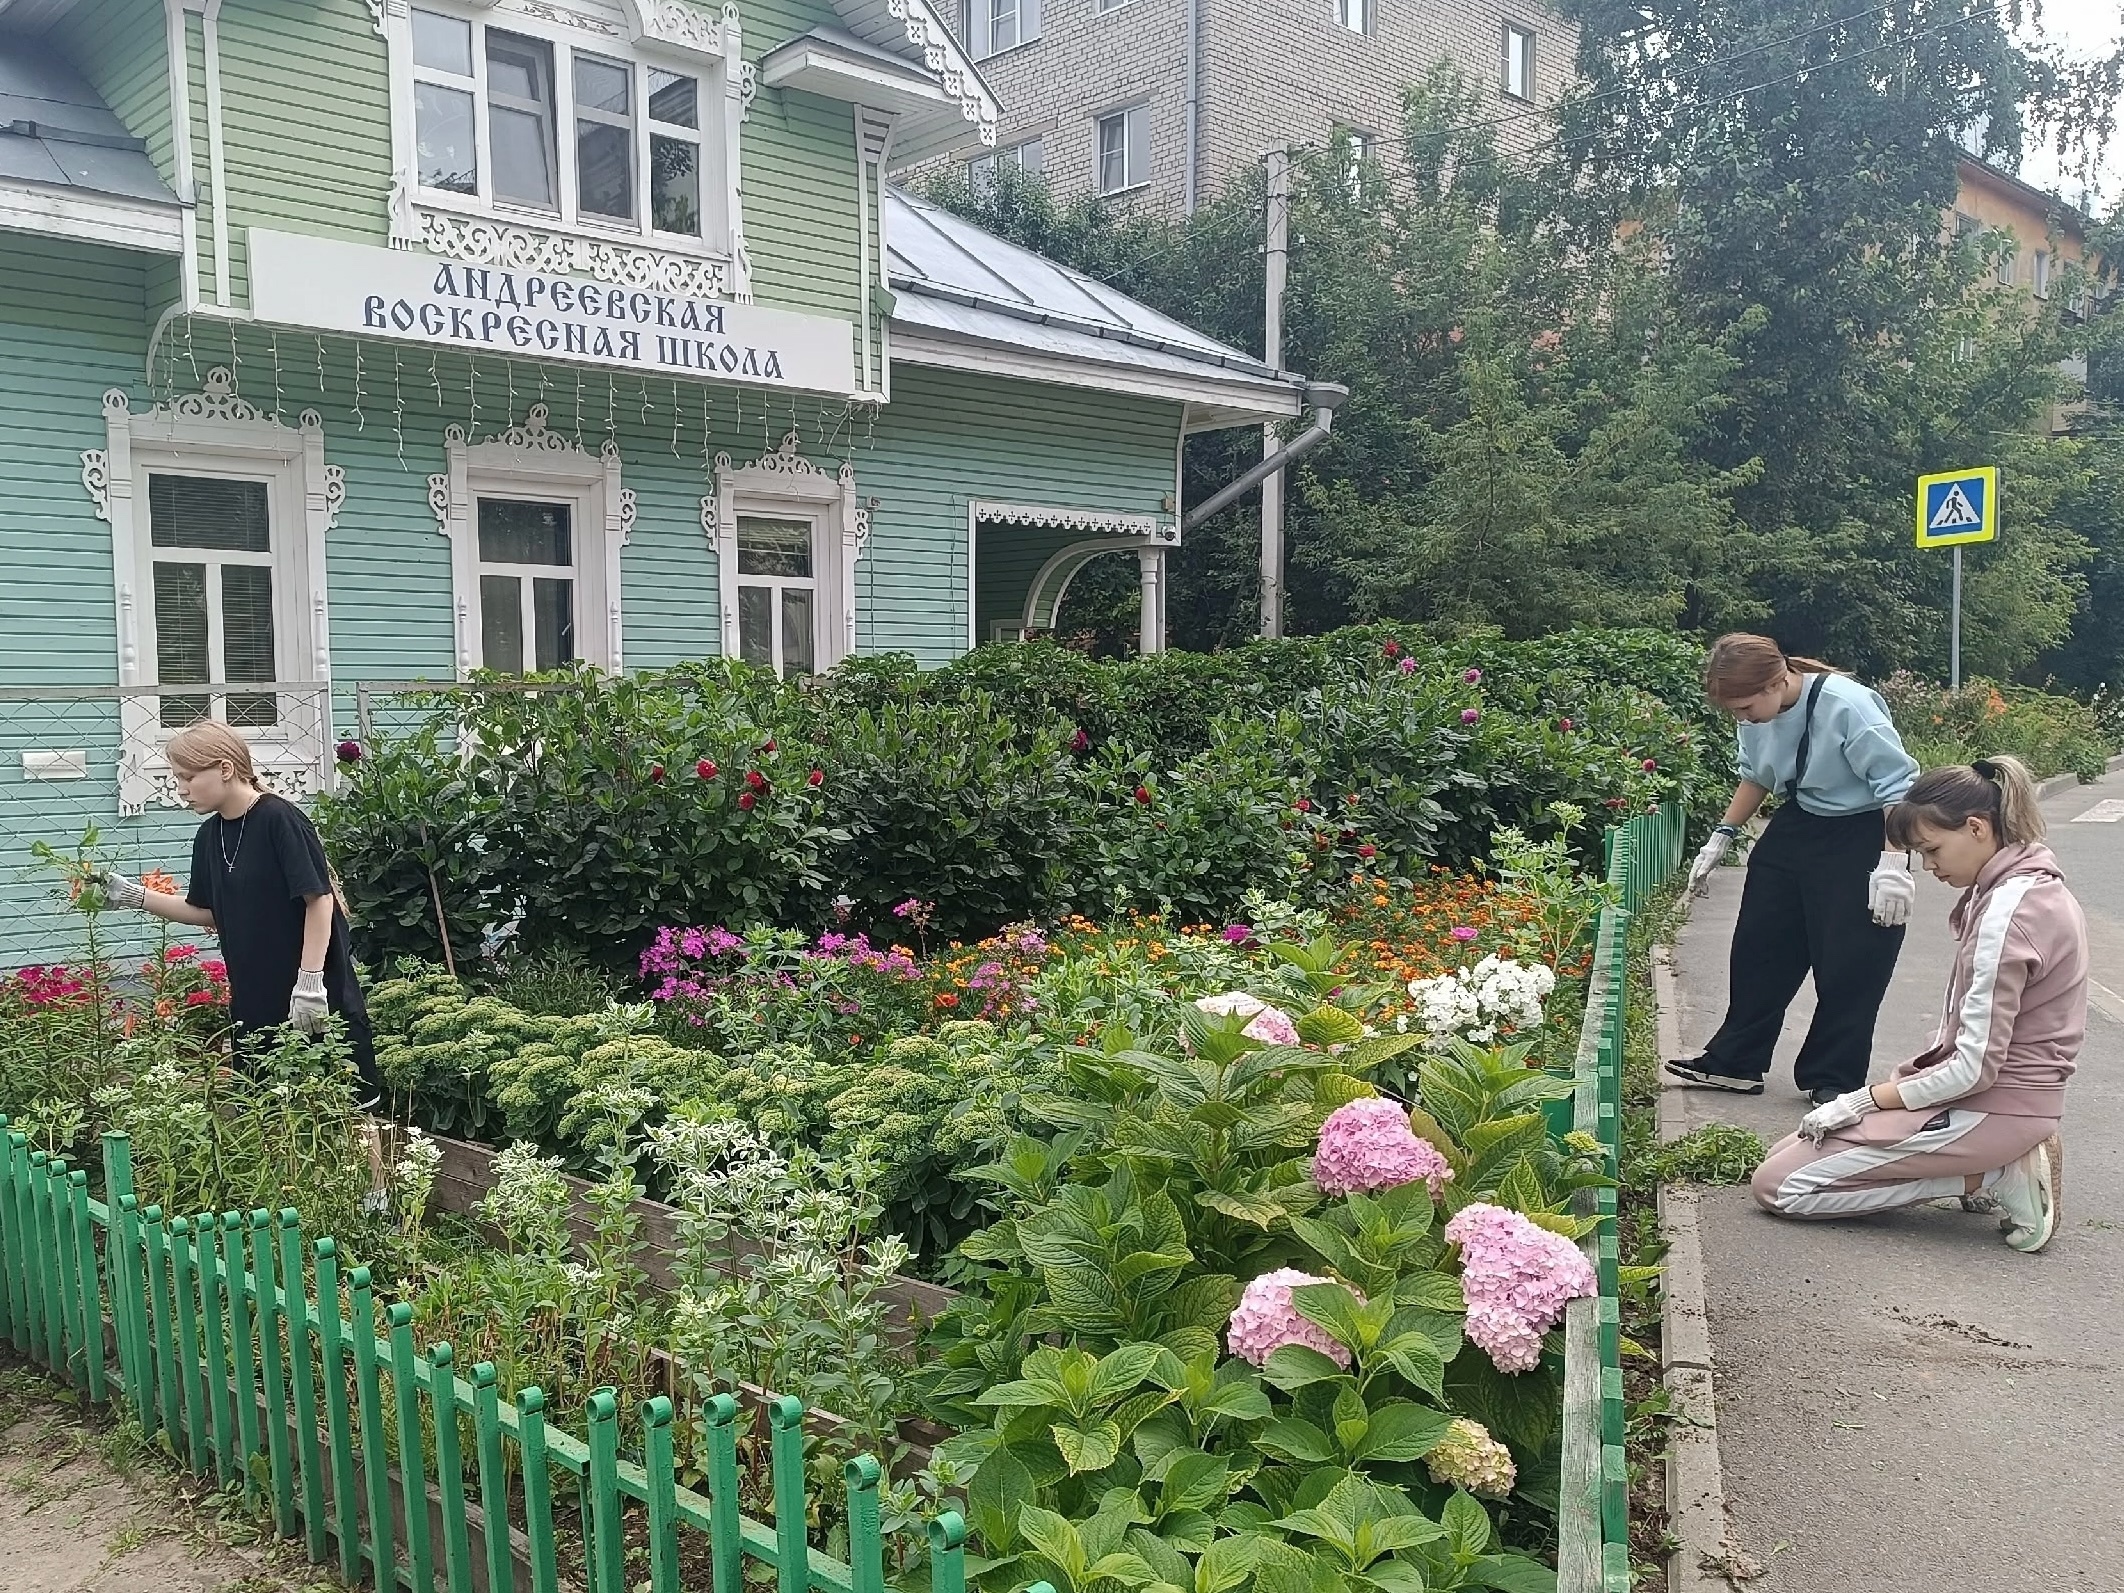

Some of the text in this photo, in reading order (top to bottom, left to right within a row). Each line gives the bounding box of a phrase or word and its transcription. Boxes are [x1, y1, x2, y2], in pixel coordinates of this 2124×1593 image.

[362, 295, 785, 380] ВОСКРЕСНАЯ ШКОЛА
[432, 262, 727, 335] АНДРЕЕВСКАЯ
